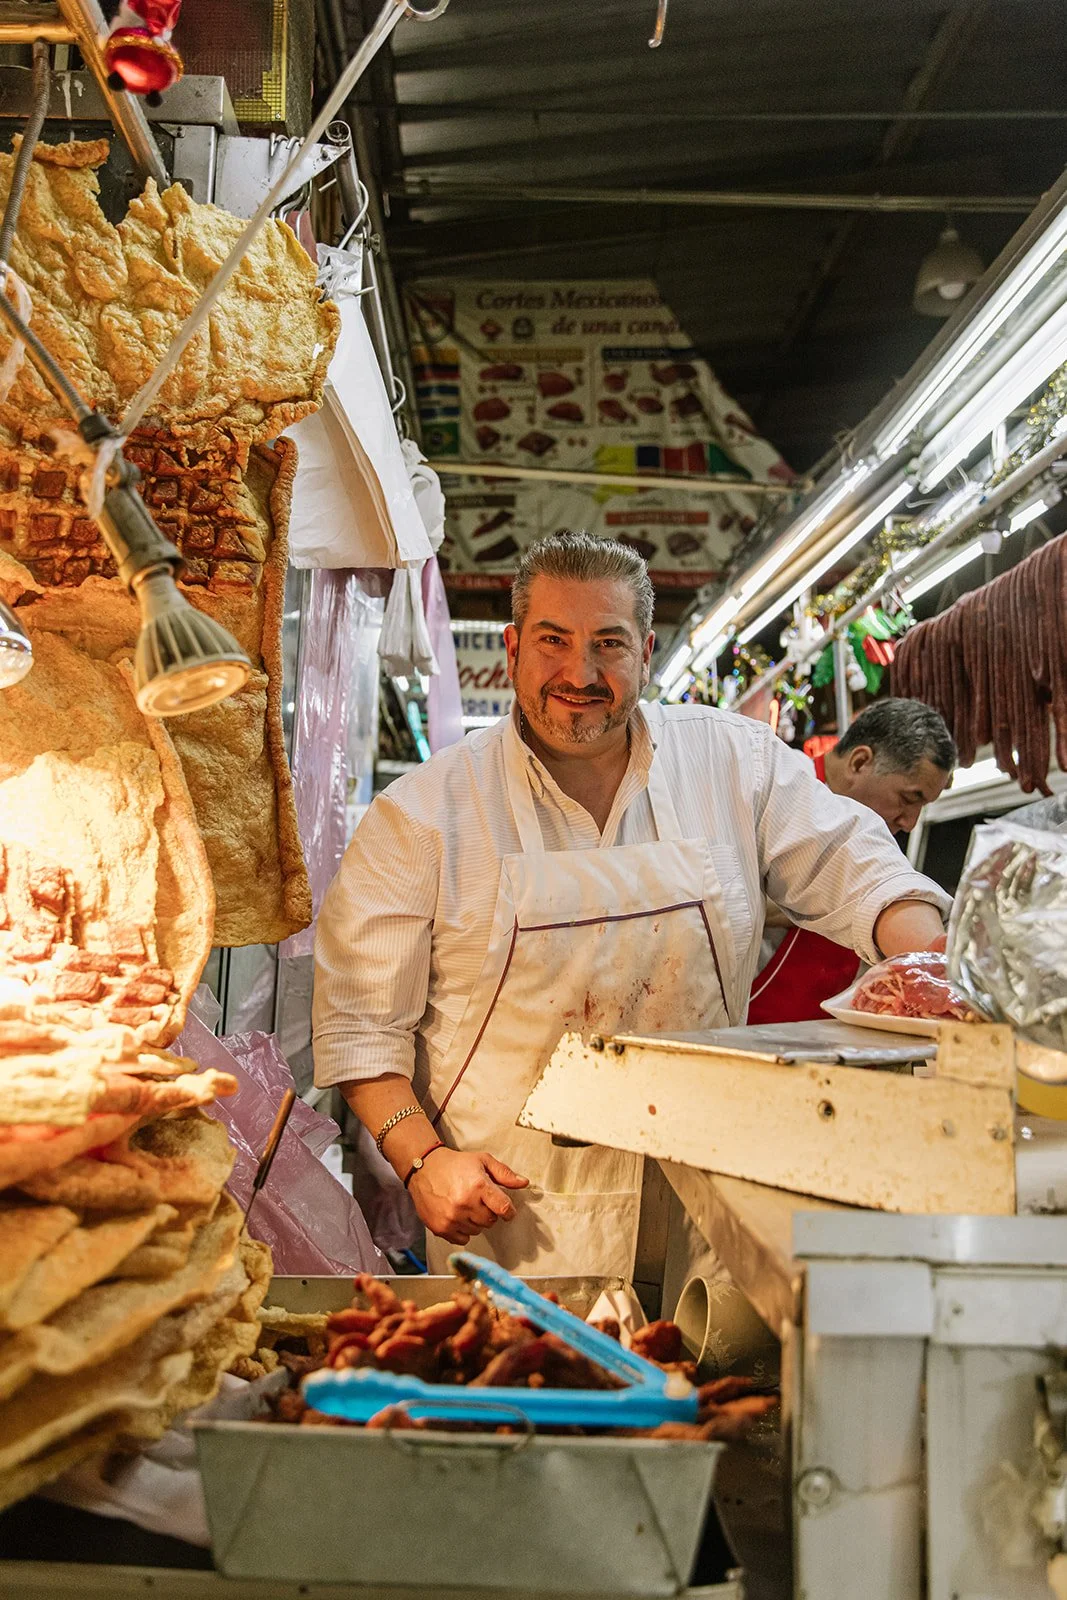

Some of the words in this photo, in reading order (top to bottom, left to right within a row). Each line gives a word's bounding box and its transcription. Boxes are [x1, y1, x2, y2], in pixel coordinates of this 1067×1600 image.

[477, 290, 545, 310] Cortes
[551, 313, 577, 334] de
[582, 320, 622, 334] una
